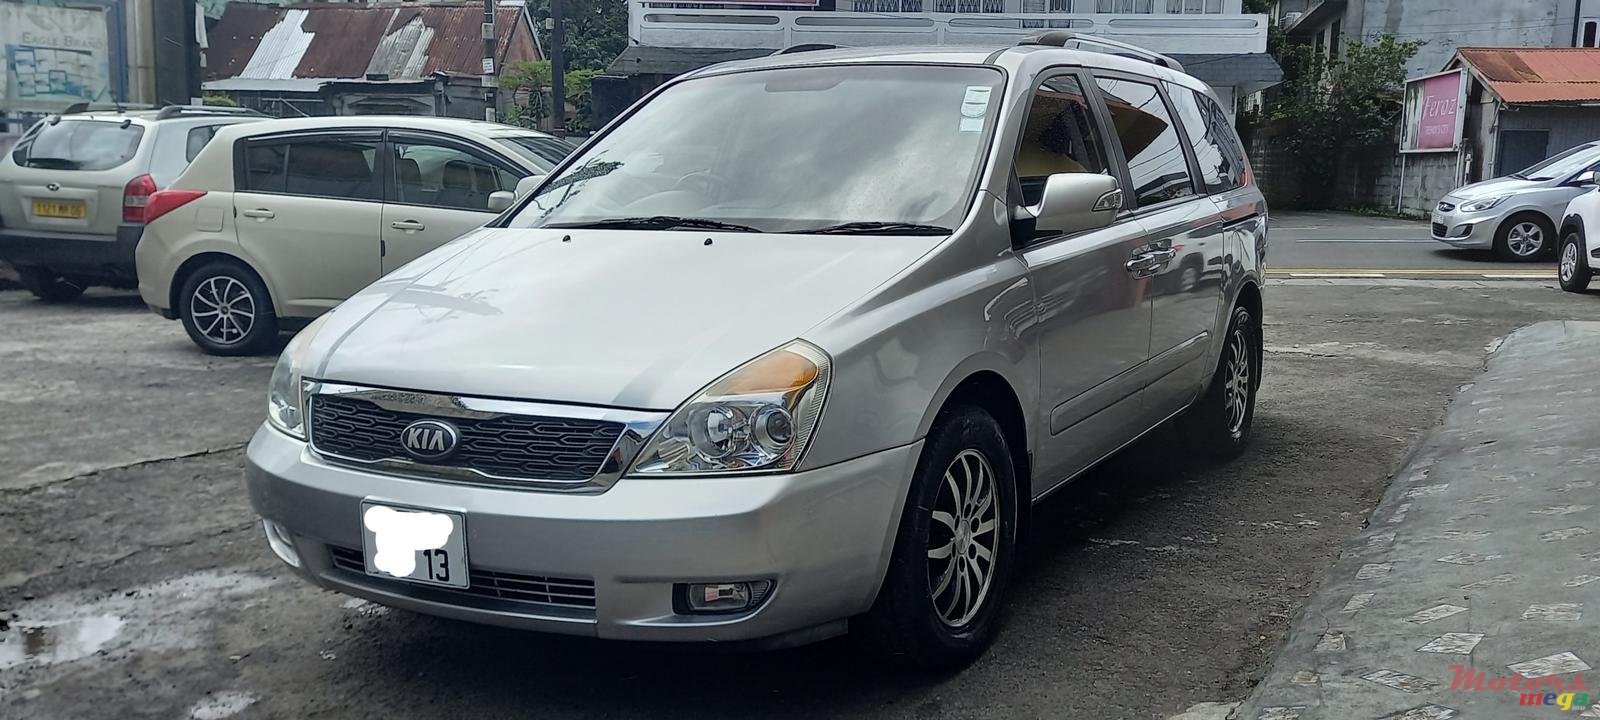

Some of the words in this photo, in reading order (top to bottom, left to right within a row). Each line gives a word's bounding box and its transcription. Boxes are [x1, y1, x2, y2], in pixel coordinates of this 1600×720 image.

[1422, 95, 1457, 120] Feroz
[407, 427, 445, 451] KIA
[423, 548, 449, 582] 13
